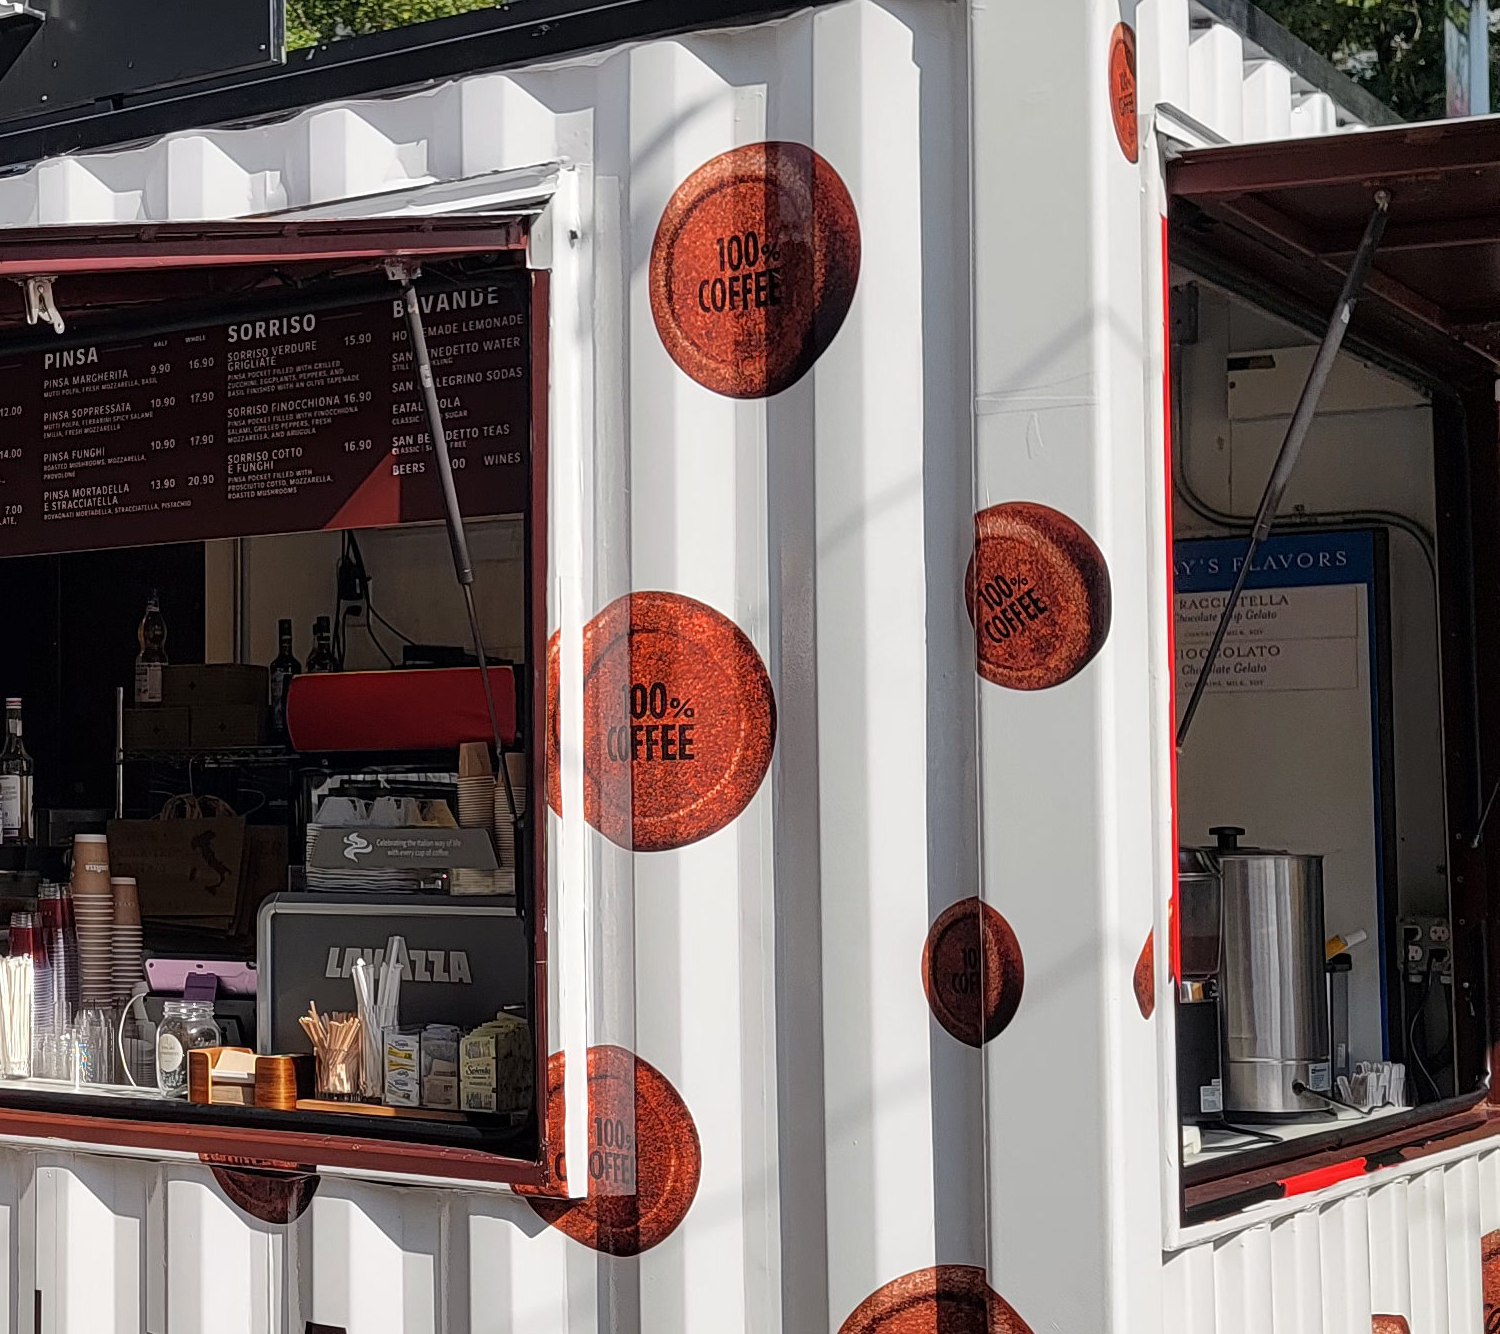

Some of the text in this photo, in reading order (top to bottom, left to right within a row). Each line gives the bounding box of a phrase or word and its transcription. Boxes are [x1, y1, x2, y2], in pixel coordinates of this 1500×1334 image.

[716, 231, 780, 272] 100%
[393, 287, 499, 318] BVANDE
[699, 268, 781, 315] COFFEE
[228, 314, 315, 342] SORRISO
[392, 314, 523, 341] HOEMADE LEMONADE
[44, 347, 98, 370] PINSA
[227, 333, 372, 362] SORRISO VERDURE 15.90
[392, 337, 521, 363] SAN WATER
[44, 357, 214, 389] PINSA MARGHERITA 9.90 16.90
[228, 356, 277, 371] GRIGLIATE
[392, 367, 522, 392] SAN SODAS
[0, 406, 22, 417] 12.00
[44, 392, 214, 422] PINSA SOPPRESSATA 10.90 17.90
[227, 391, 372, 418] SORRISO FINOCCHIONA 16.90
[393, 401, 423, 414] EATAL
[44, 435, 214, 462] PINSA FUNGHI 10.90 17.90
[392, 424, 510, 447] SAN BEDETTO TEAS
[0, 449, 22, 459] 14.00
[227, 440, 372, 464] SORRISO COTTO 16.90
[393, 453, 521, 475] BEERS WINES
[228, 461, 274, 474] E FUNGHI
[44, 475, 214, 501] PINSA MORTADELLA 13.90 20.90
[5, 505, 22, 514] 7.00
[44, 496, 118, 511] E STRACCIATELLA
[978, 570, 1030, 609] 100%
[984, 588, 1049, 645] COFFEE
[1245, 609, 1277, 621] Gelato
[1233, 661, 1267, 674] Gelato
[622, 681, 694, 720] 100%
[606, 723, 694, 762] COFFEE
[325, 936, 472, 983] LAVAZZA
